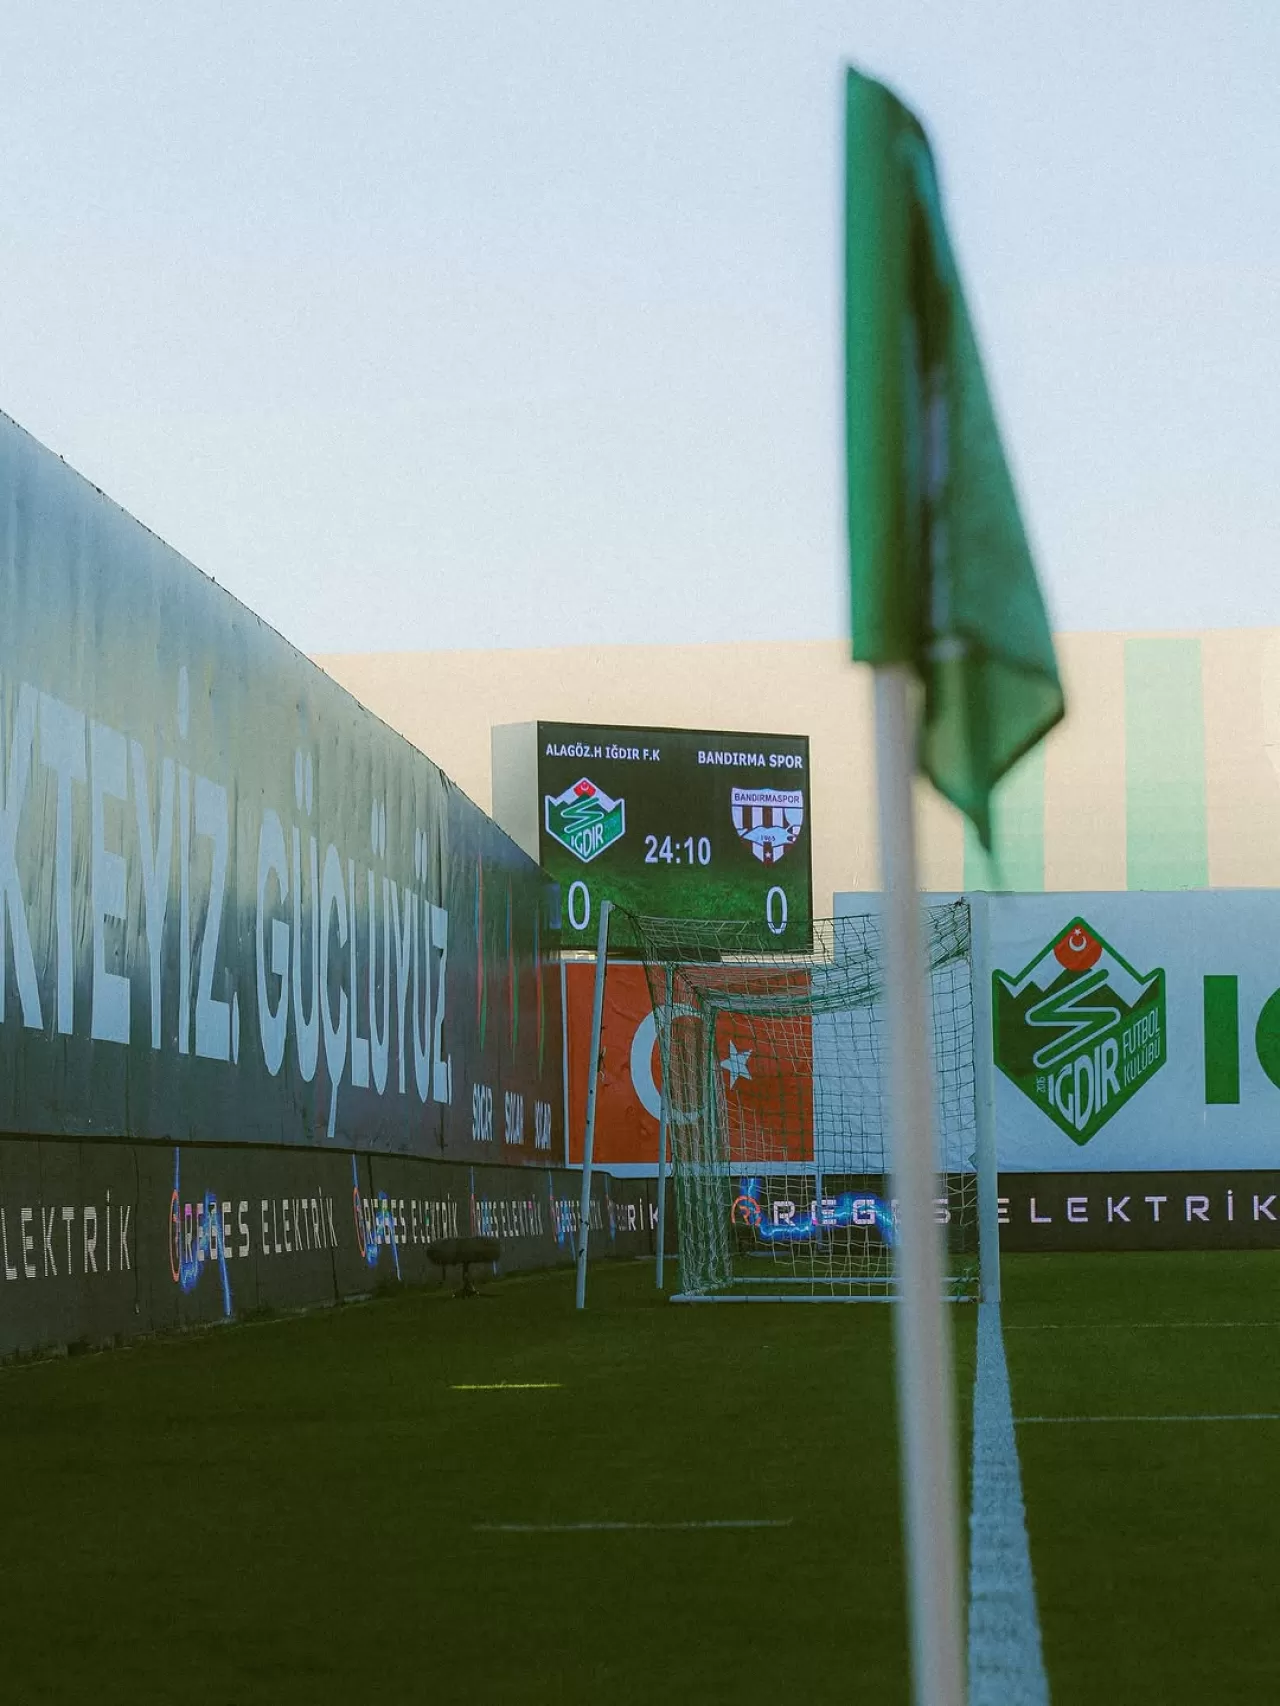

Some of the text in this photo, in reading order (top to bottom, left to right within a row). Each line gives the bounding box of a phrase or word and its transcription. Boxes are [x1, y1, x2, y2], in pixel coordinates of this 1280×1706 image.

[546, 742, 602, 758] ALAGÖZ.H
[605, 744, 640, 760] IĞDIR
[697, 750, 803, 769] BANDIRMA SPOR
[734, 793, 800, 804] BANDIRMASPOR
[644, 834, 711, 865] 24:10
[567, 880, 591, 931] 0
[766, 886, 788, 935] 0
[1122, 1007, 1161, 1060] FUTBOL
[261, 1185, 338, 1256] ELEKTRİK
[773, 1198, 952, 1227] REGS
[0, 1188, 131, 1281] LEKTRİK
